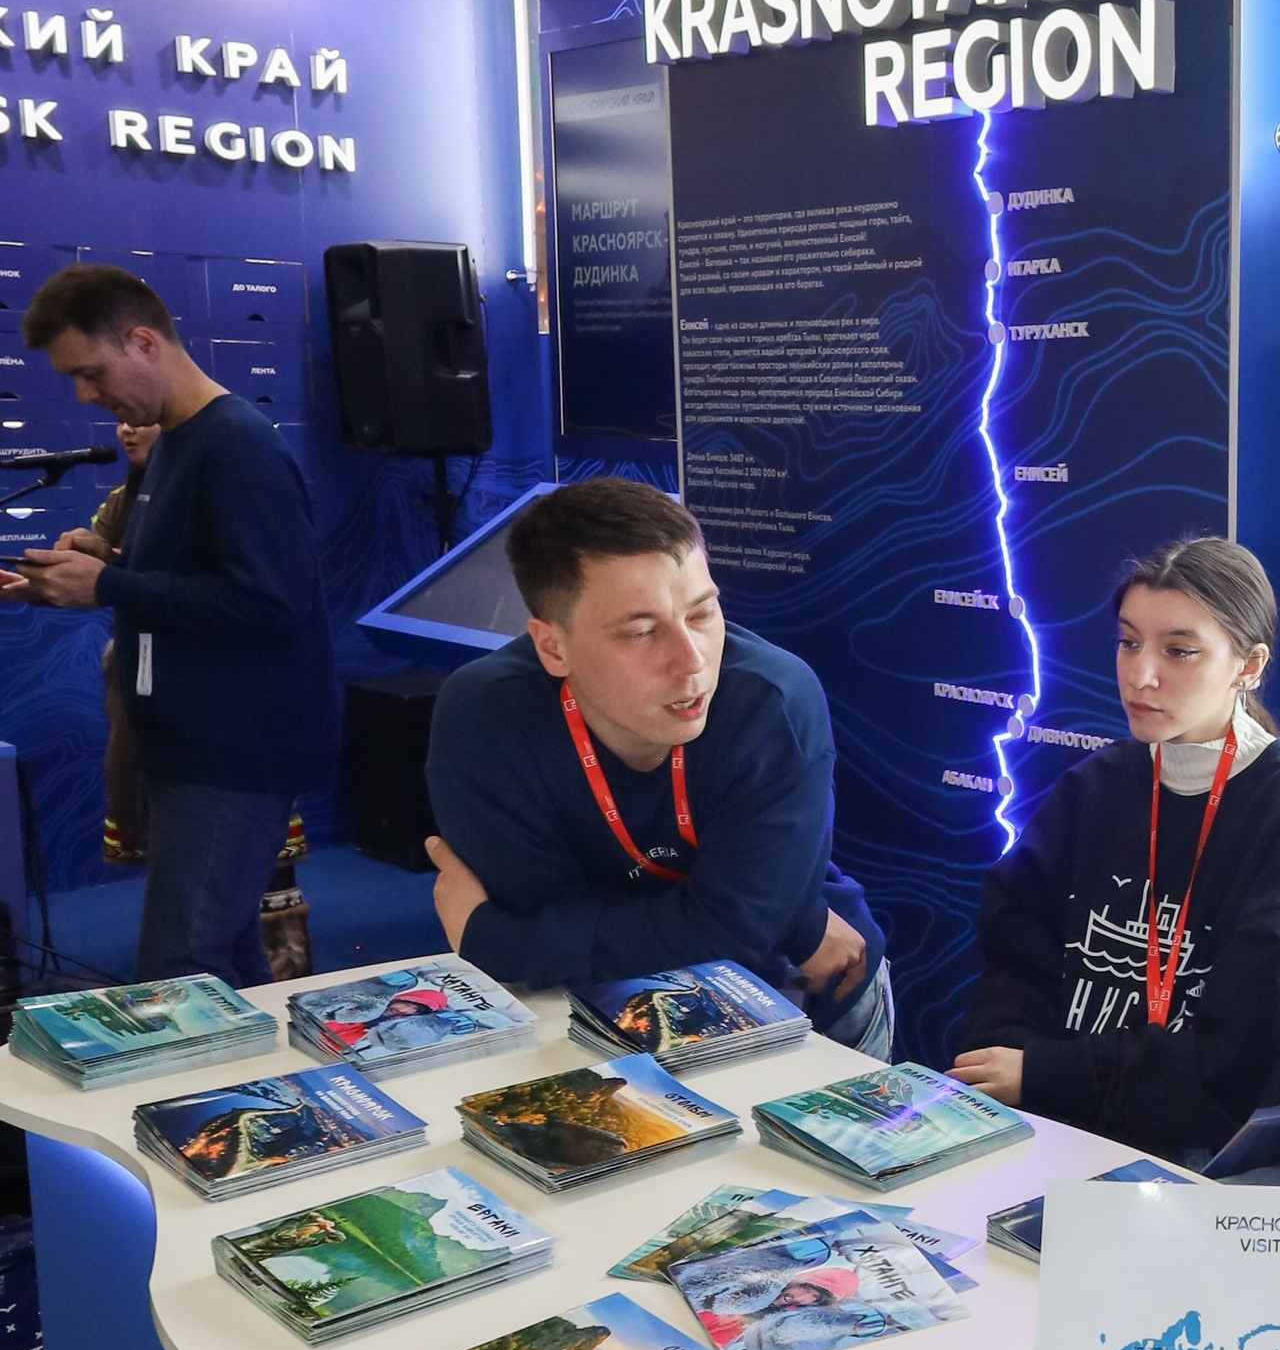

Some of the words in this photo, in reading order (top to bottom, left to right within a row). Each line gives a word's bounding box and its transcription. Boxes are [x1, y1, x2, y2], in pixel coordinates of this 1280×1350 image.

[175, 35, 347, 94] КРАЙ
[108, 109, 356, 173] REGION
[572, 199, 637, 221] МАРШРУТ
[1007, 187, 1074, 211] ДУДИНКА
[573, 264, 639, 288] ДУДИНКА
[1007, 257, 1062, 277] ИГАРКА
[1009, 322, 1090, 341] ТУРУХАНСК
[250, 367, 276, 375] ЛЕНТА
[1014, 463, 1068, 483] ЕНИСЕЙ
[934, 589, 1000, 611] ЕНИСЕЙСК
[934, 682, 1015, 709] КРАСНОЯРСК
[942, 770, 993, 793] АБАКАН
[899, 1067, 939, 1086] ПЛАТО
[467, 1203, 520, 1238] ЕРГАКИ
